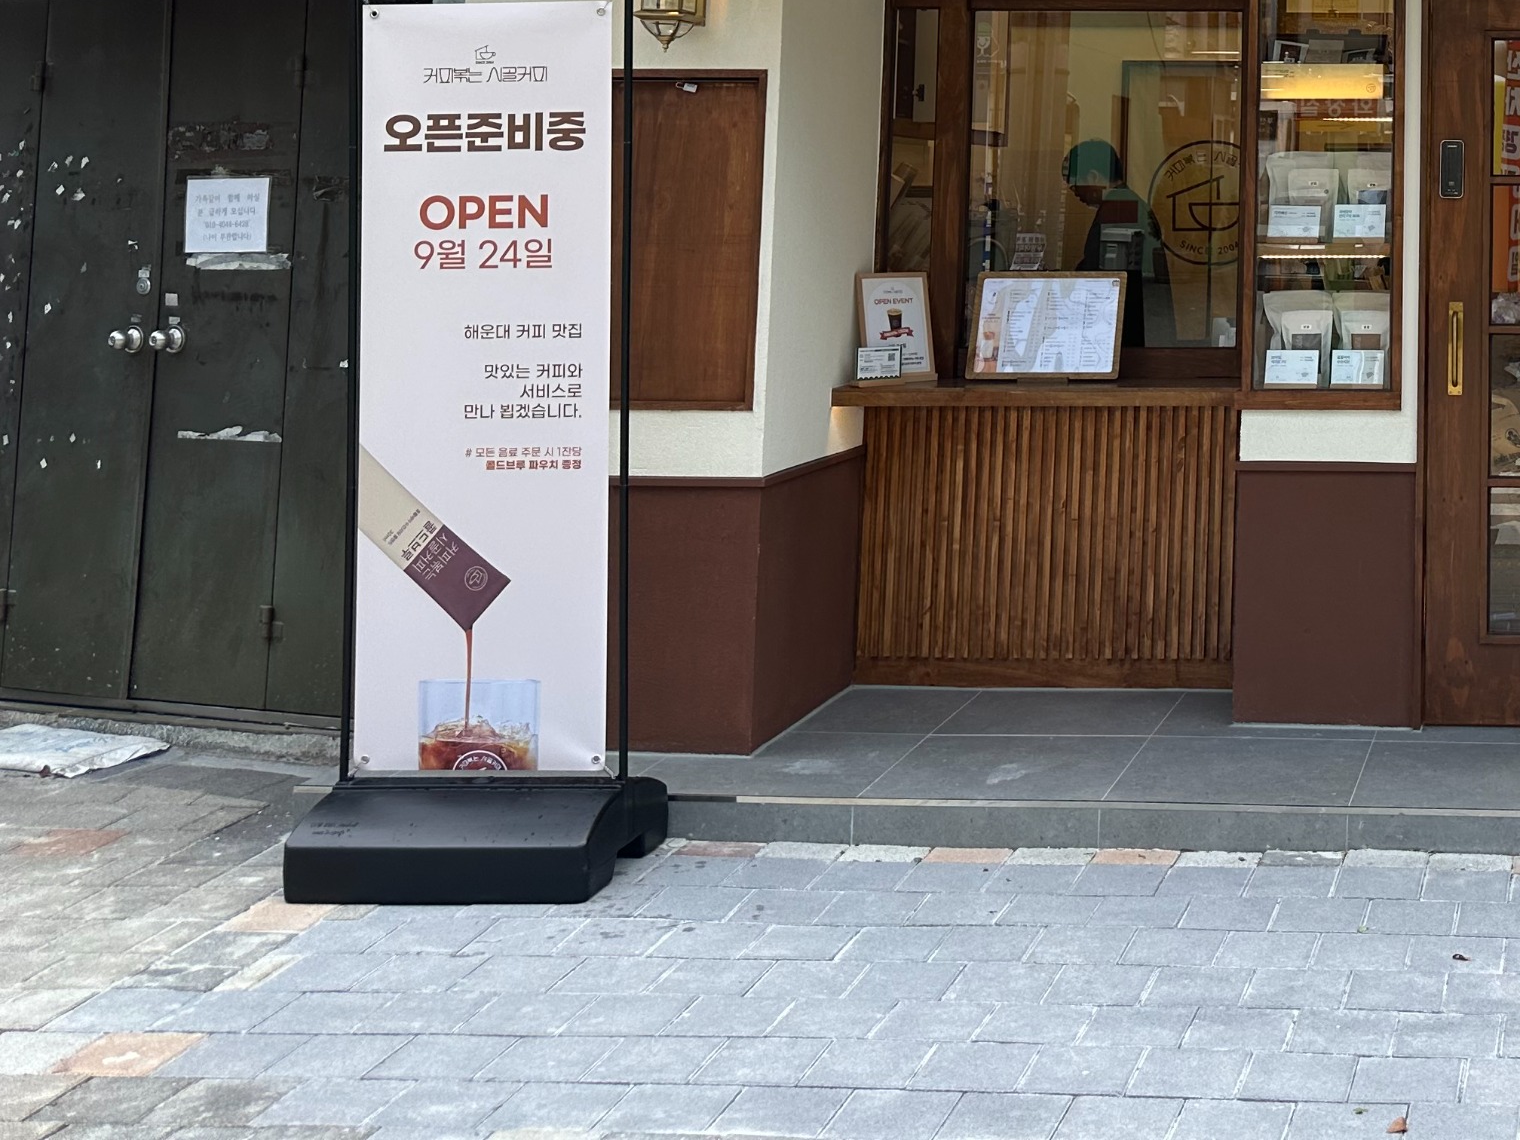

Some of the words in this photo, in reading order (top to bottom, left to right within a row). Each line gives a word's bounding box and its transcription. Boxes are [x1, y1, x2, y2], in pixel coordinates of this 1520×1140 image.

[384, 111, 586, 153] 오픈준비중
[419, 194, 549, 231] OPEN
[413, 239, 467, 270] 9월
[478, 238, 553, 269] 24일
[464, 324, 511, 340] 해운대
[516, 324, 547, 340] 커피
[552, 323, 583, 339] 맛집
[484, 363, 531, 379] 맛있는
[536, 363, 583, 379] 커피와
[520, 383, 583, 399] 서비스로
[464, 404, 495, 419] 만나
[499, 403, 583, 419] 뵙겠습니다.
[475, 447, 495, 457] 모든
[498, 447, 519, 457] 음료
[521, 447, 541, 457] 주문
[544, 447, 554, 457] 시
[557, 446, 582, 457] 1잔당
[486, 460, 526, 471] 콜드브루
[528, 460, 559, 470] 파우치
[561, 459, 582, 470] 증정
[401, 520, 437, 561] 콜드브루
